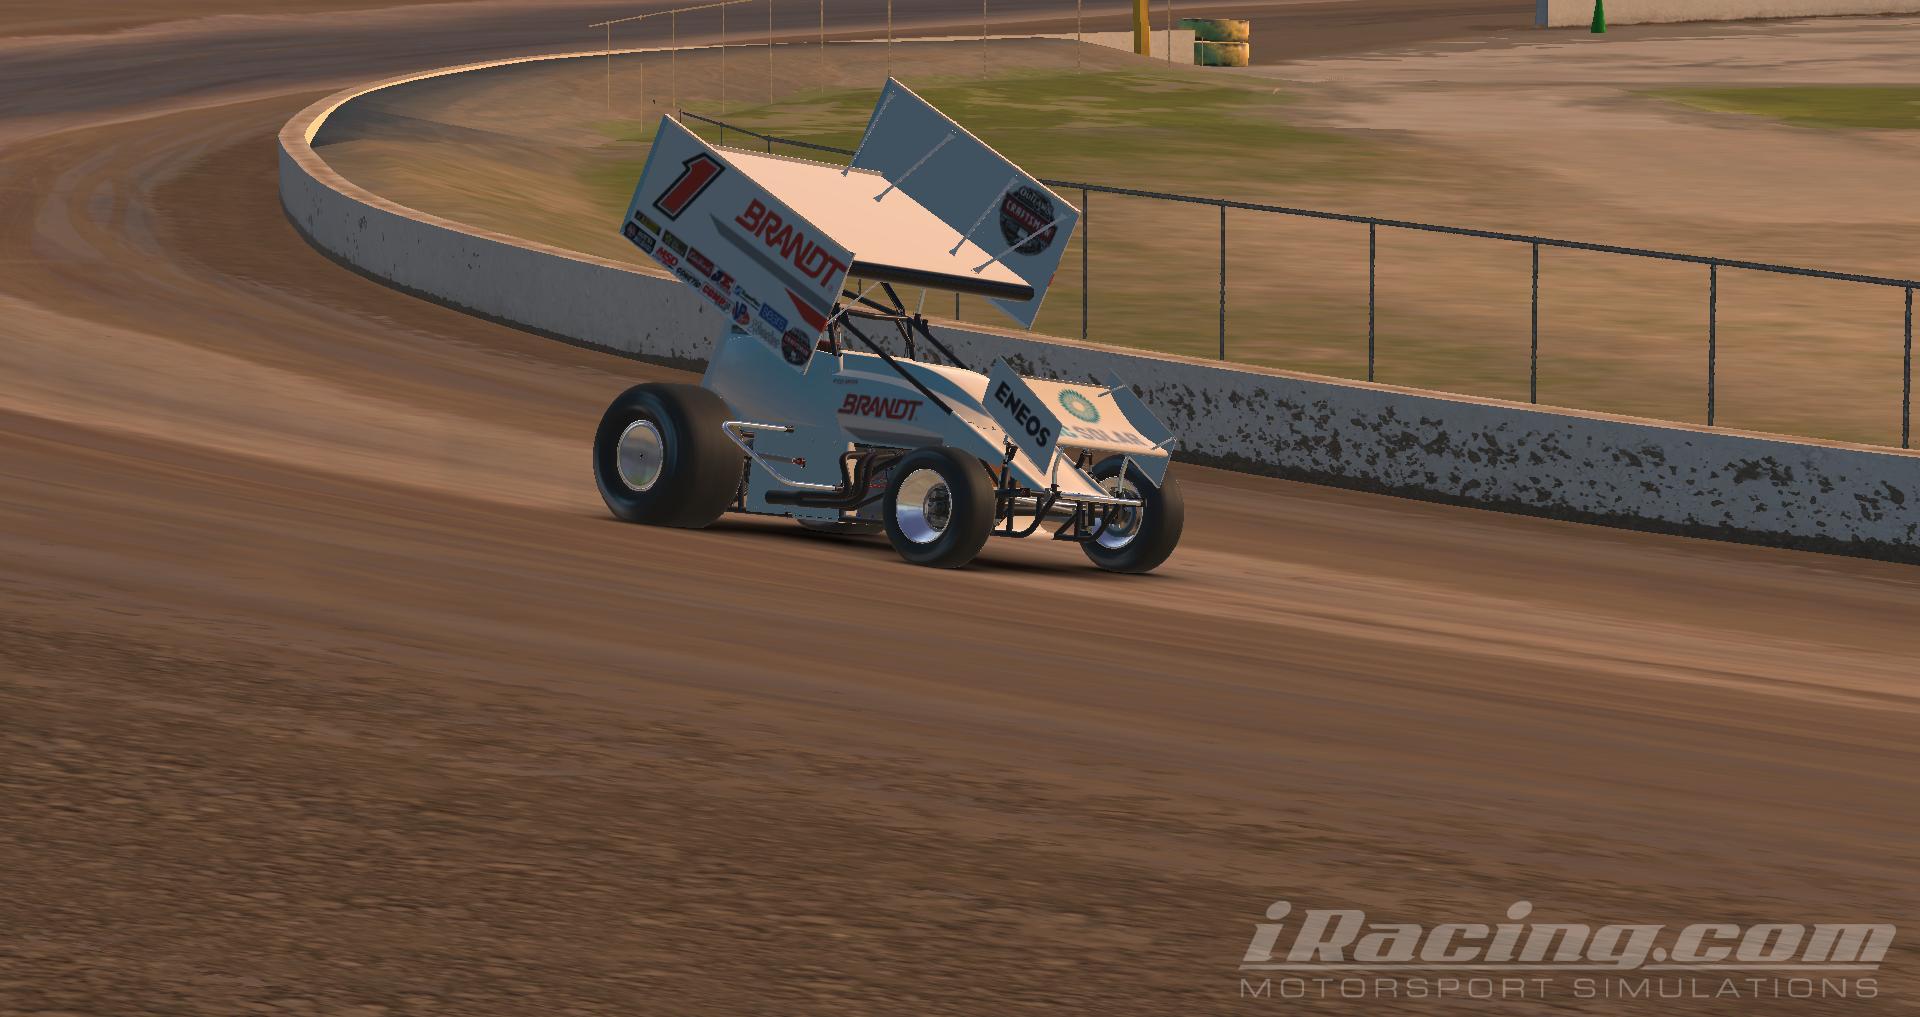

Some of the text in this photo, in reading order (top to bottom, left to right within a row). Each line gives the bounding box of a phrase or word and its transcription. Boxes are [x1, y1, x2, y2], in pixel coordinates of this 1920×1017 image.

[653, 152, 726, 221] 1
[735, 198, 848, 288] BRANDT
[837, 393, 924, 421] BRANDT
[994, 381, 1050, 448] ENEOS
